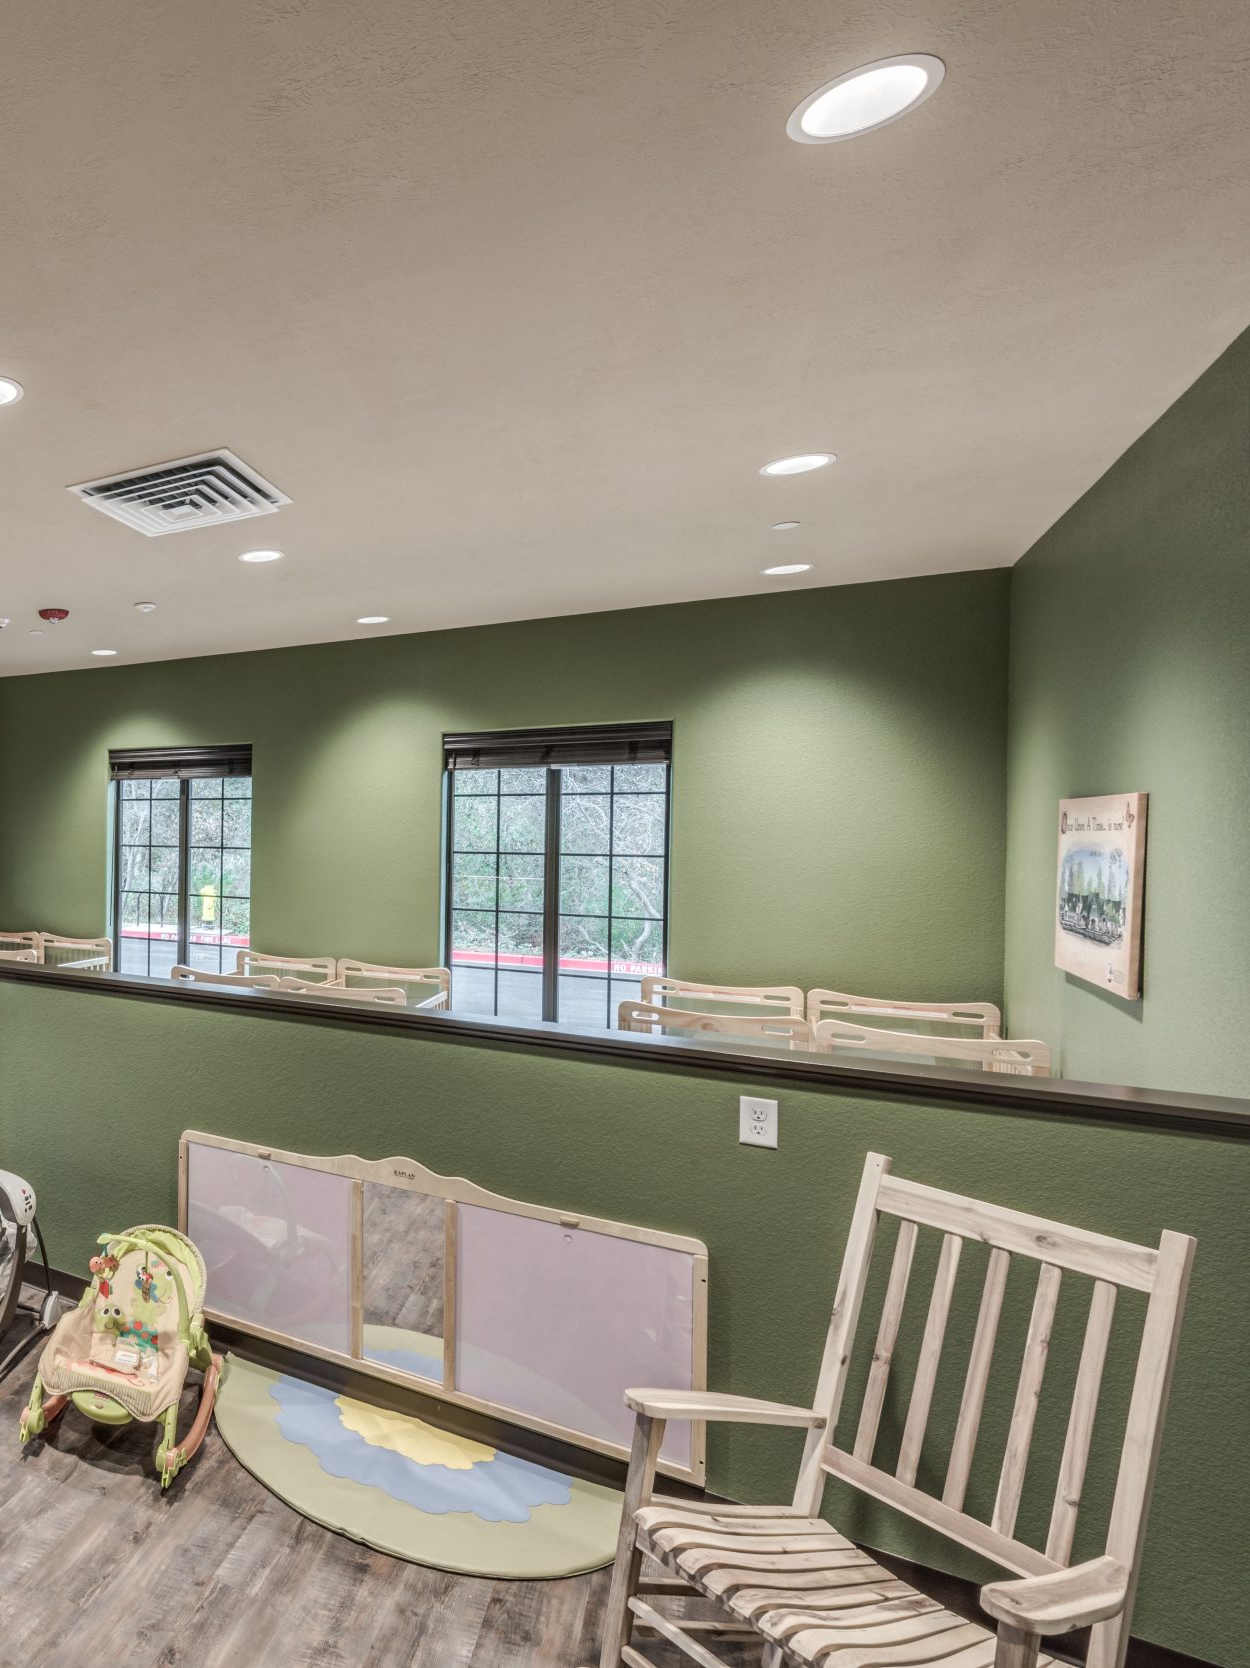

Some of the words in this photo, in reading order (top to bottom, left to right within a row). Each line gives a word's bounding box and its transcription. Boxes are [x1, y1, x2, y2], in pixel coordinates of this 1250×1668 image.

[215, 937, 231, 945] LNE
[613, 963, 627, 973] NO
[630, 965, 663, 976] PARKIN
